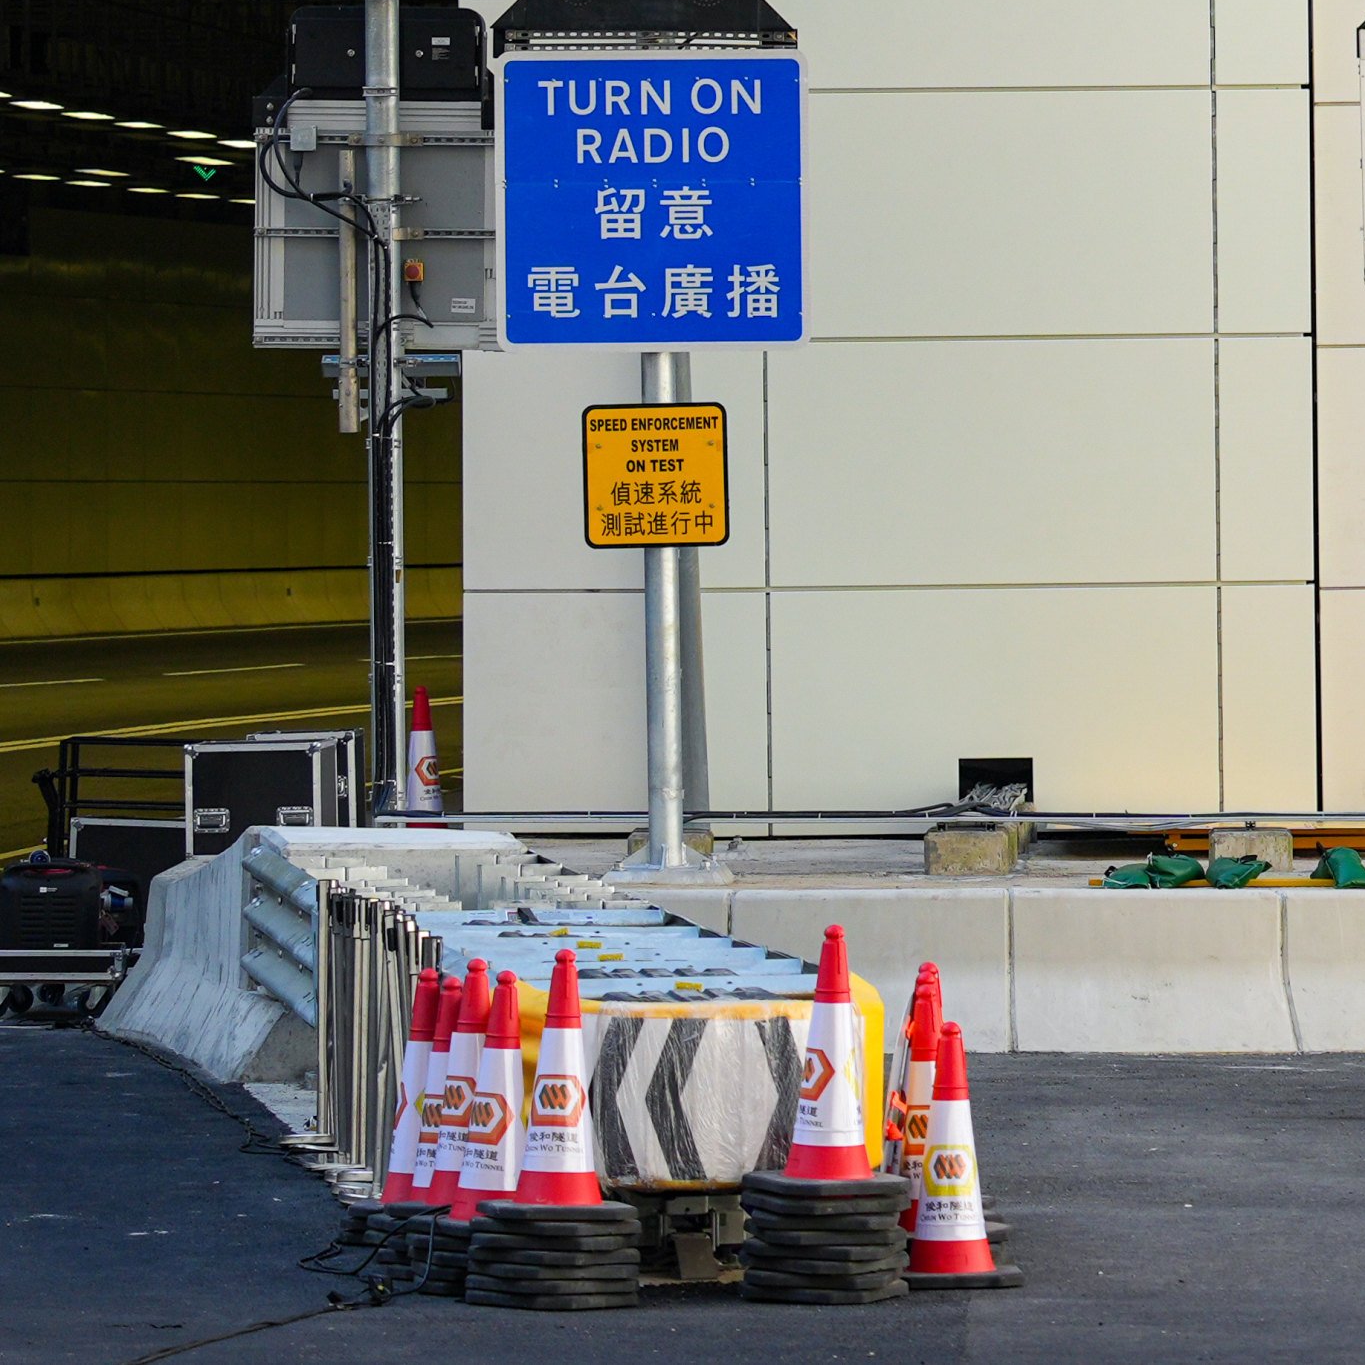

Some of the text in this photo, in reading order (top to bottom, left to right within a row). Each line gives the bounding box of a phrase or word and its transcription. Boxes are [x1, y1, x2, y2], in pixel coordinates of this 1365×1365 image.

[538, 78, 762, 116] TURN ON
[575, 126, 730, 164] RADIO
[594, 185, 714, 240] 留意
[526, 264, 780, 319] 電台廣播
[590, 416, 718, 432] SPEED ENFORCEMENT
[631, 439, 679, 452] SYSTEM
[626, 459, 684, 472] ON TEST
[611, 480, 702, 506] 偵速系統
[601, 510, 713, 537] 測試進行中
